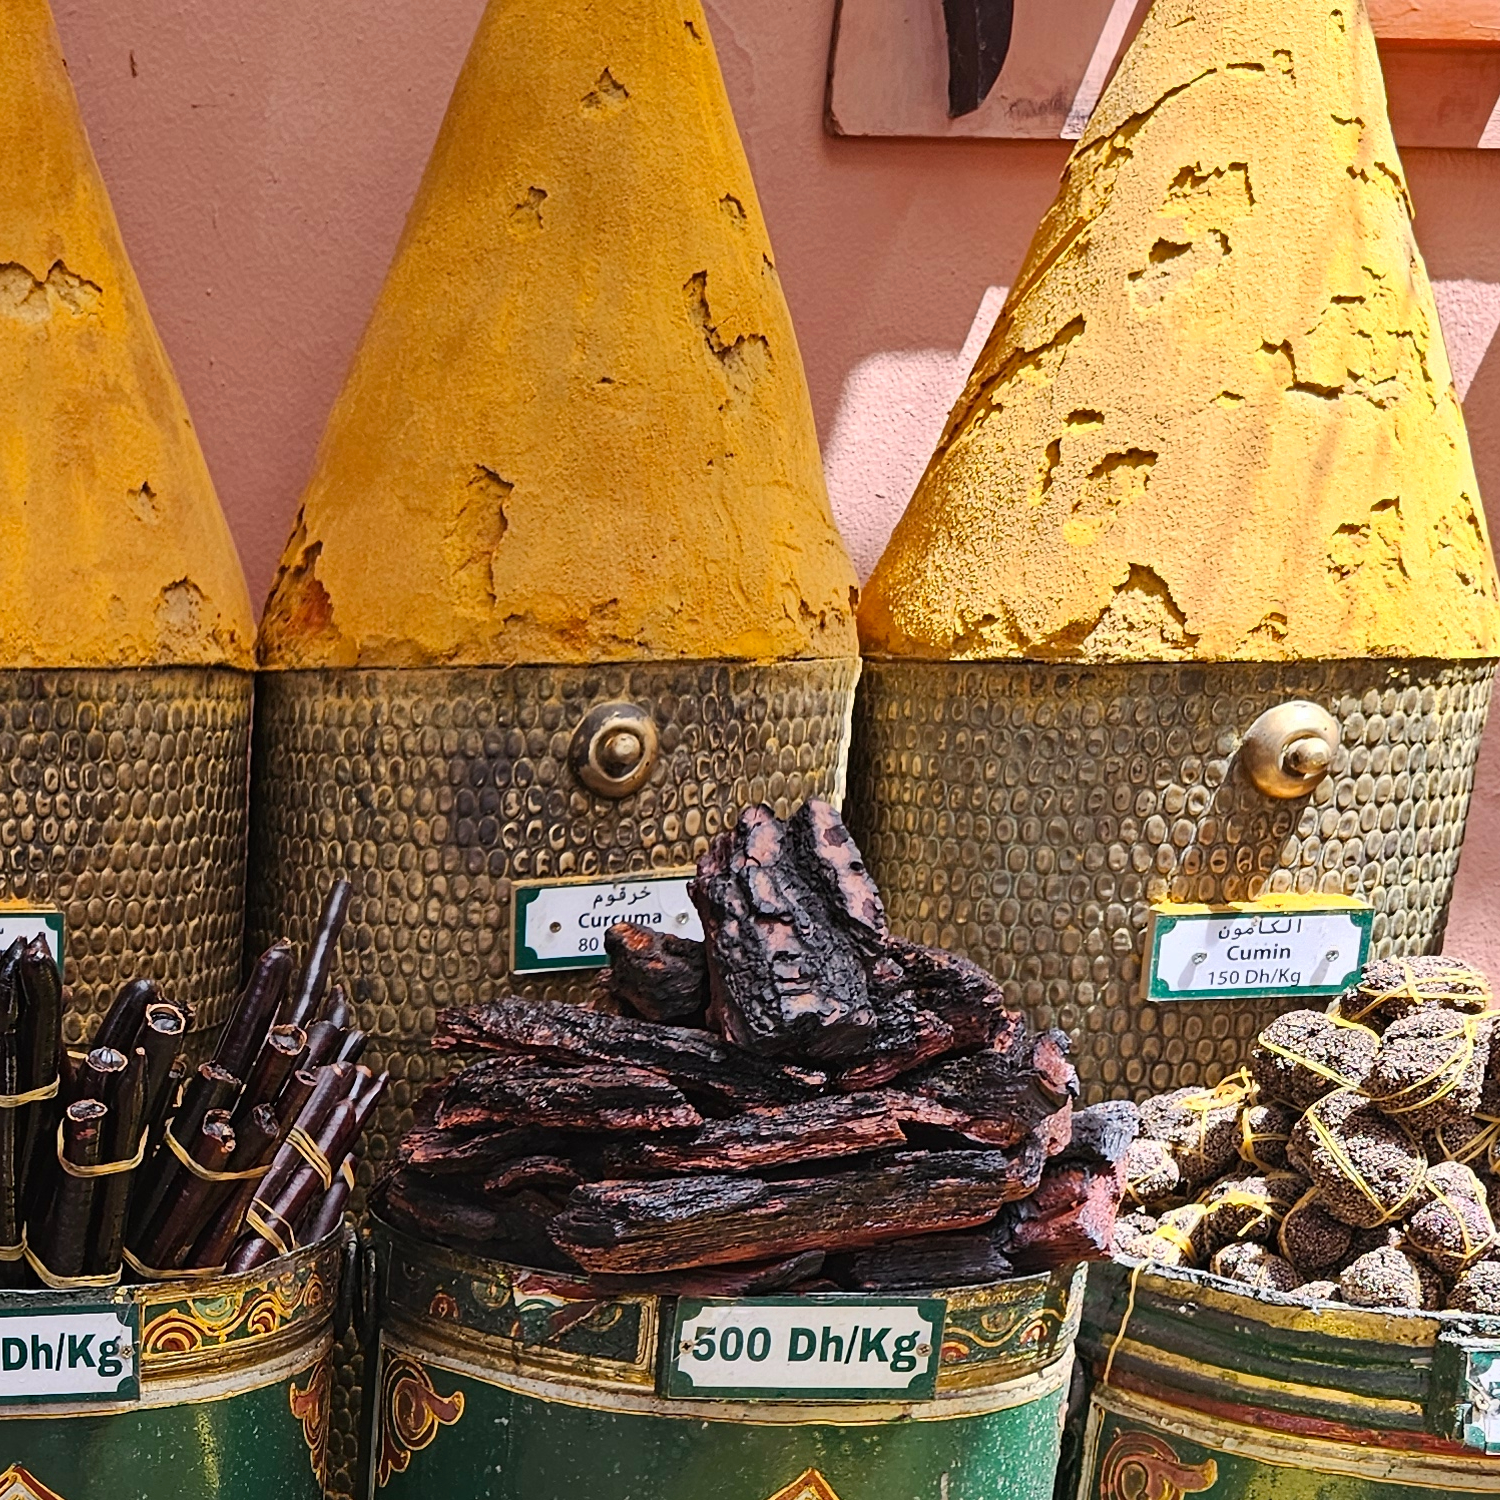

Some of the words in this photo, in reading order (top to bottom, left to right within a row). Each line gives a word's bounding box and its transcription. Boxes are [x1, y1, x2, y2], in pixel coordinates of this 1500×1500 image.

[593, 886, 651, 909] خرقوم
[1218, 918, 1302, 940] الكامون
[578, 937, 599, 952] 80
[1227, 943, 1291, 961] Cumin
[1208, 970, 1240, 985] 150
[1245, 967, 1301, 987] Dh/Kg
[2, 1332, 124, 1378] Dh/Kg
[692, 1326, 772, 1362] 500
[787, 1325, 921, 1373] Dh/Kg
